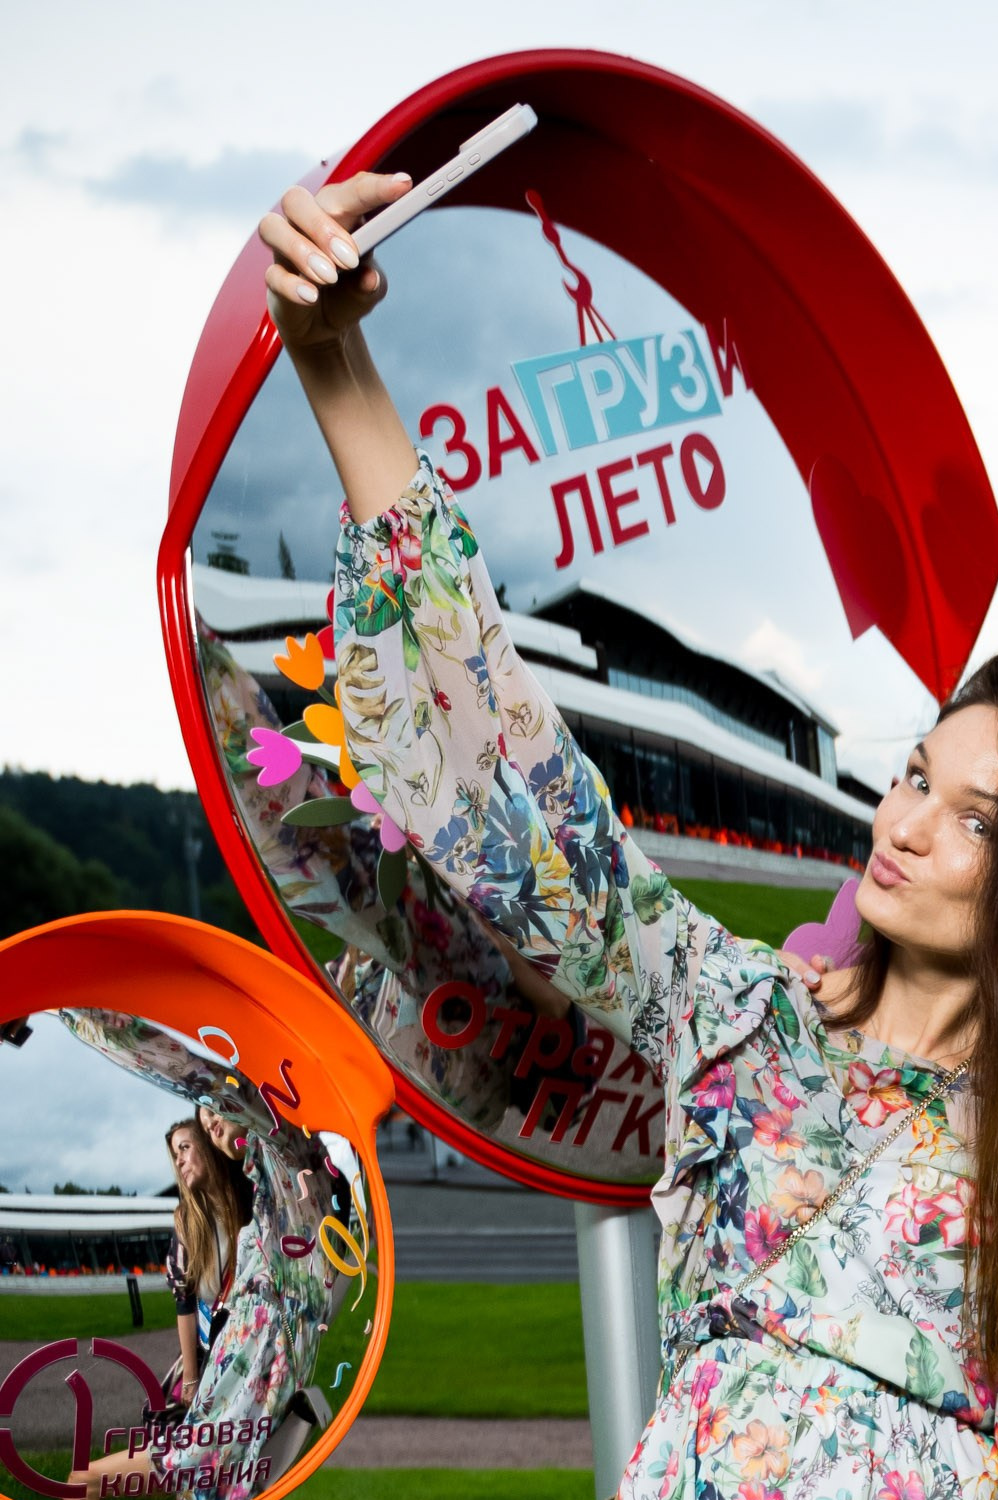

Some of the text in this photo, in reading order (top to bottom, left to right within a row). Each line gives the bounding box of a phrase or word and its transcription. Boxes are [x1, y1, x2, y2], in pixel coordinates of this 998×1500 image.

[419, 318, 754, 493] ЗАГРУЗИ
[550, 432, 727, 570] ЛЕТО
[100, 1456, 272, 1498] компания
[104, 1415, 273, 1459] грузовая
